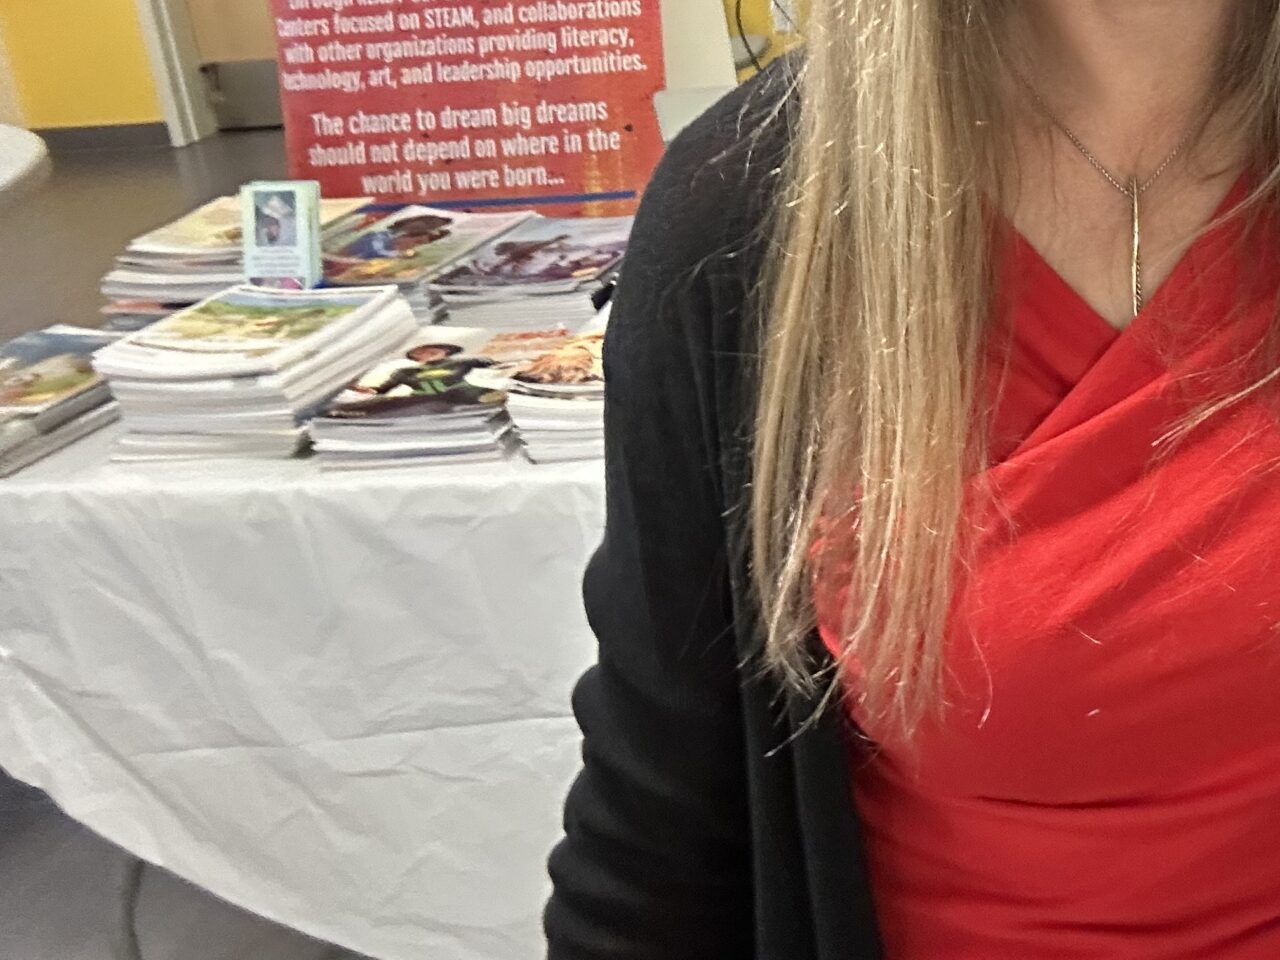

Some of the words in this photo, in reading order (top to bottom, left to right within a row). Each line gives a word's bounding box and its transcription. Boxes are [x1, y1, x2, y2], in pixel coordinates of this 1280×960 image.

[334, 10, 394, 35] focused
[398, 11, 420, 31] on
[424, 4, 480, 30] STEAM,
[482, 2, 514, 26] and
[317, 39, 363, 63] other
[366, 32, 474, 64] organizations
[478, 28, 557, 58] providing
[560, 25, 635, 49] literacy,
[368, 65, 398, 89] art,
[401, 62, 433, 85] and
[436, 55, 521, 85] leadership
[524, 49, 647, 81] opportunities.
[310, 112, 343, 136] The
[349, 109, 411, 135] chance
[415, 107, 436, 131] to
[440, 105, 497, 129] dream
[501, 101, 532, 130] big
[536, 99, 608, 124] dreams
[308, 141, 366, 167] should
[369, 141, 400, 164] not
[403, 136, 471, 166] depend
[474, 136, 497, 159] on
[501, 131, 560, 157] where
[563, 128, 583, 153] in
[586, 126, 621, 151] the
[361, 169, 412, 194] world
[416, 170, 451, 196] you
[454, 166, 500, 189] were
[503, 163, 565, 187] born...
